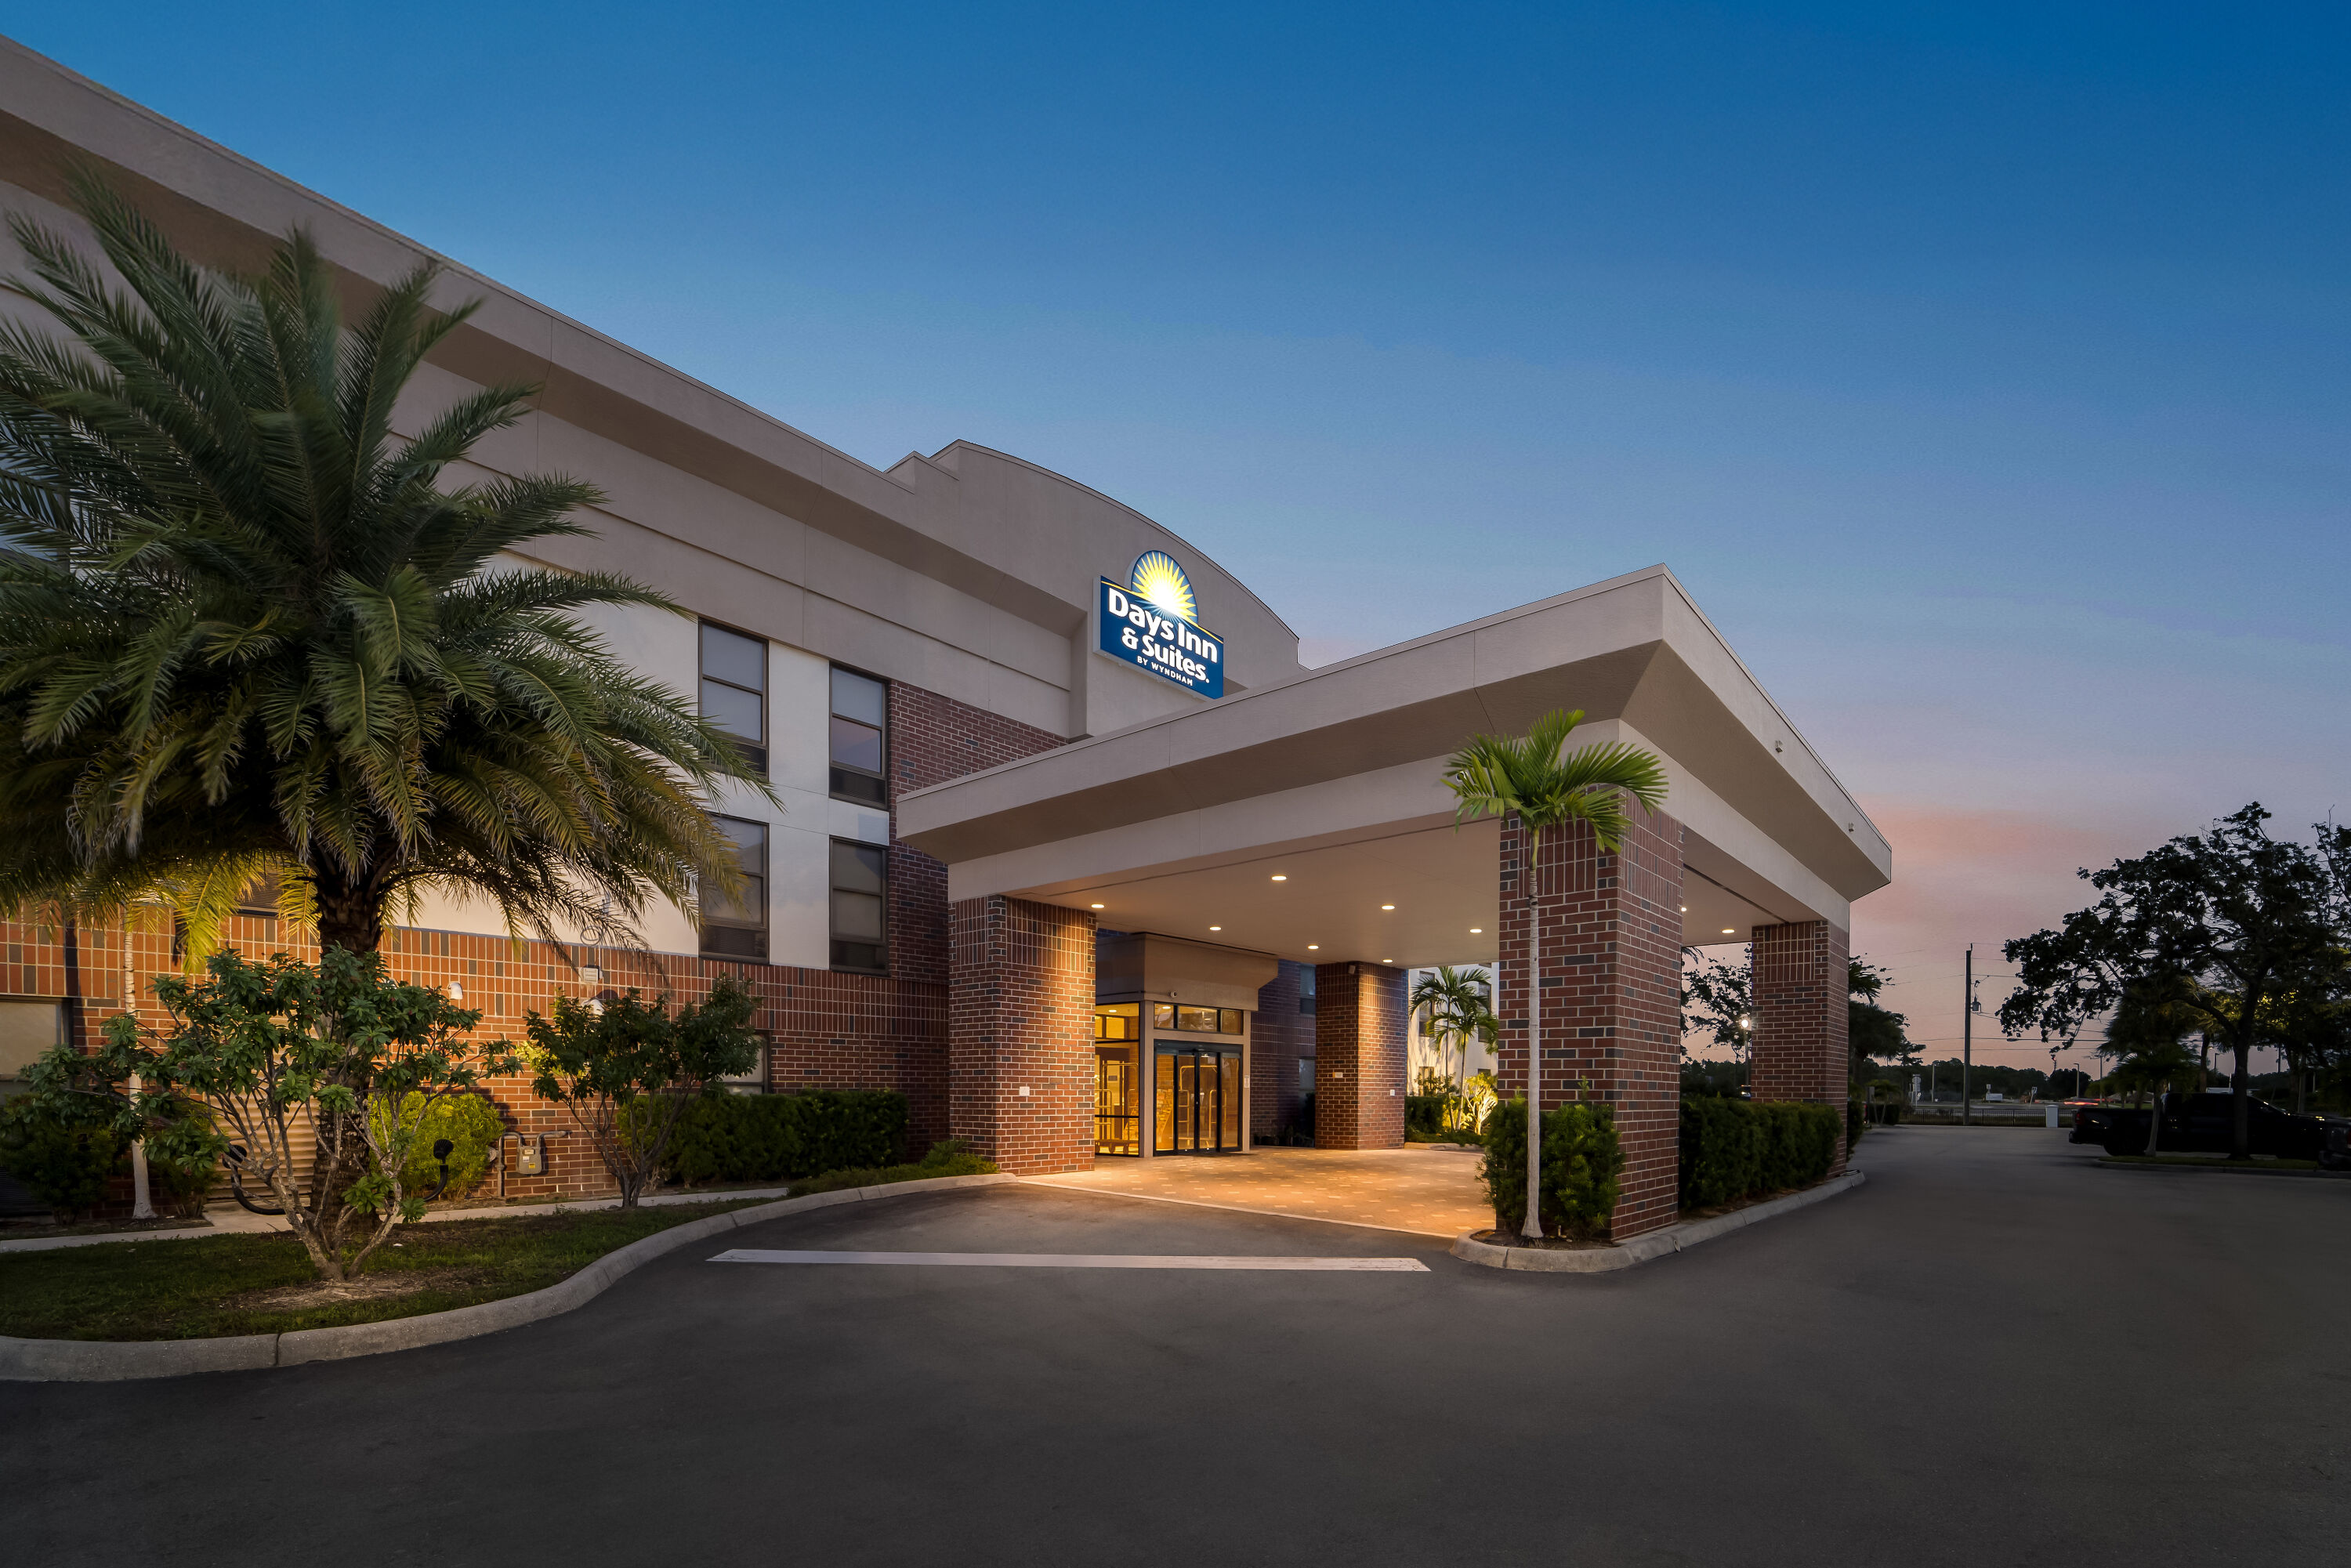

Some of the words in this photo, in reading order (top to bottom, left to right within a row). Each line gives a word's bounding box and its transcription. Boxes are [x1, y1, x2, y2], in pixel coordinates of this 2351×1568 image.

[1109, 588, 1174, 640] Days
[1178, 623, 1217, 663] Inn
[1121, 627, 1139, 650] &
[1137, 655, 1148, 665] BY
[1151, 661, 1193, 686] WYNDHAM
